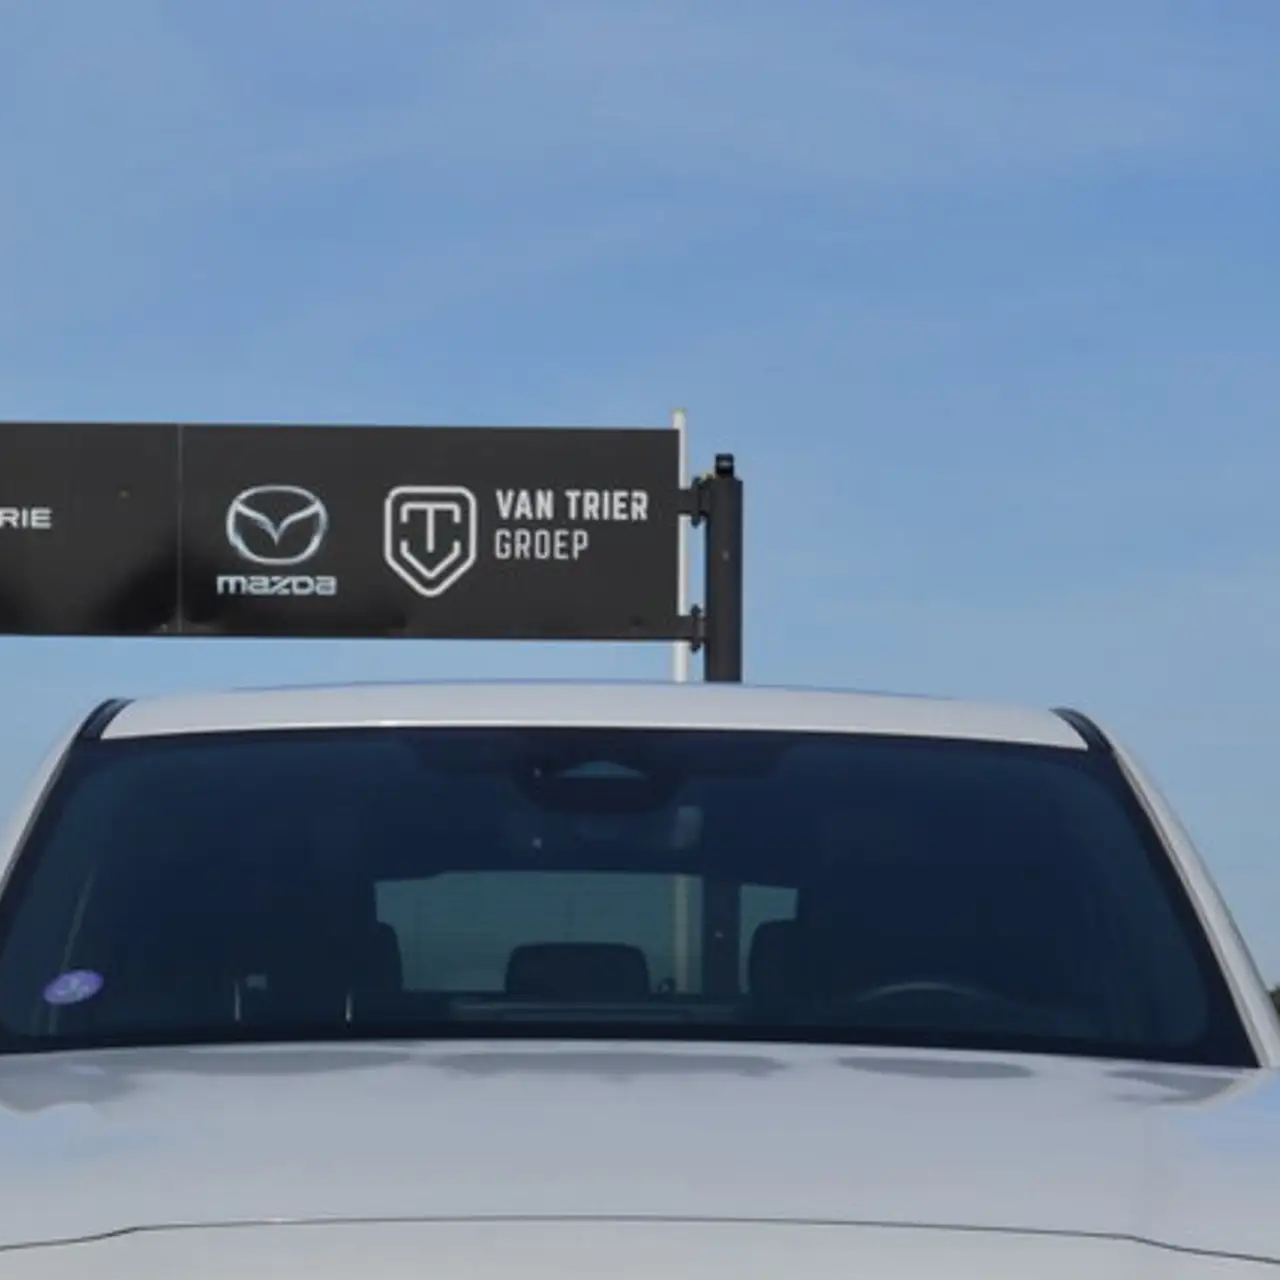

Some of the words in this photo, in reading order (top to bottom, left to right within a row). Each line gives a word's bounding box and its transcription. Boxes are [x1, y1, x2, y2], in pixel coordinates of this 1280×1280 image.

[495, 489, 554, 520] VAN
[565, 490, 648, 521] TRIER
[494, 528, 588, 560] GROEP
